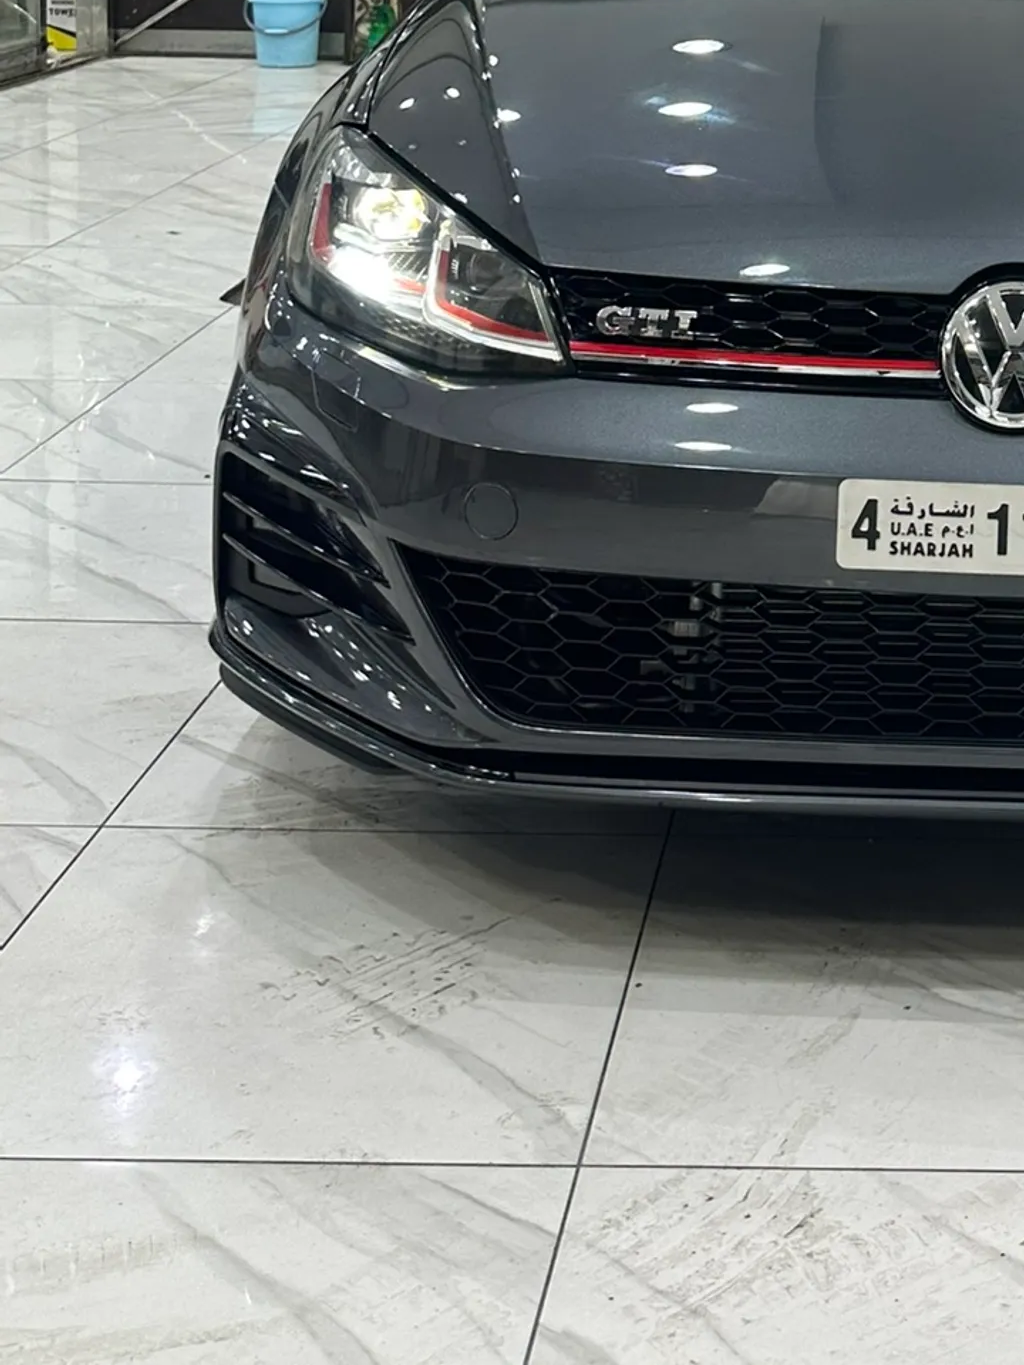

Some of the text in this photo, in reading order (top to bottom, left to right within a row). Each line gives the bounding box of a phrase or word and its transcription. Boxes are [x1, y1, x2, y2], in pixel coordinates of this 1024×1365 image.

[596, 305, 698, 341] GTI
[890, 496, 975, 520] الشارقة
[851, 498, 881, 551] 4
[890, 521, 934, 537] U.A.E
[889, 540, 974, 558] SHARJAH
